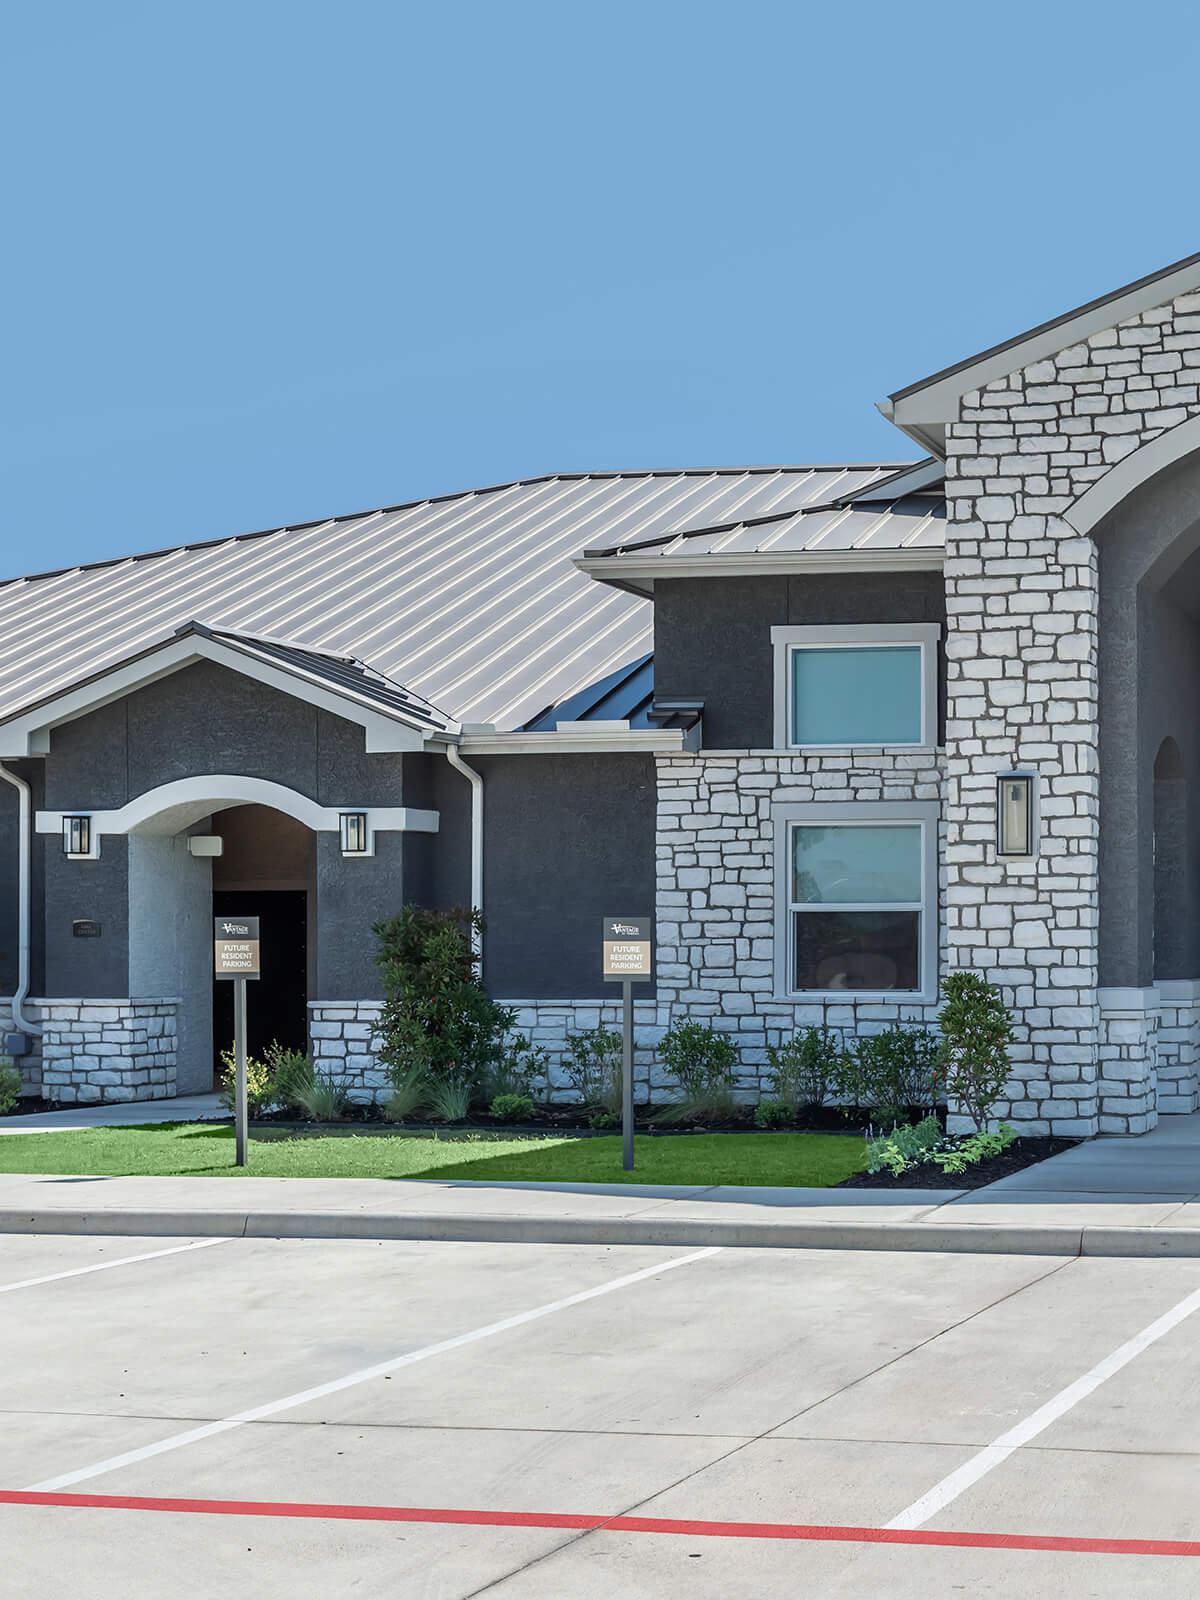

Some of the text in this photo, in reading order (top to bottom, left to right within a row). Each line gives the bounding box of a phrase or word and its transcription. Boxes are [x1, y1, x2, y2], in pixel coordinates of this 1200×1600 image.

[224, 944, 250, 952] FUTURE
[613, 945, 641, 953] FUTURE
[221, 952, 253, 960] RESIDENT
[222, 960, 253, 968] PARKING
